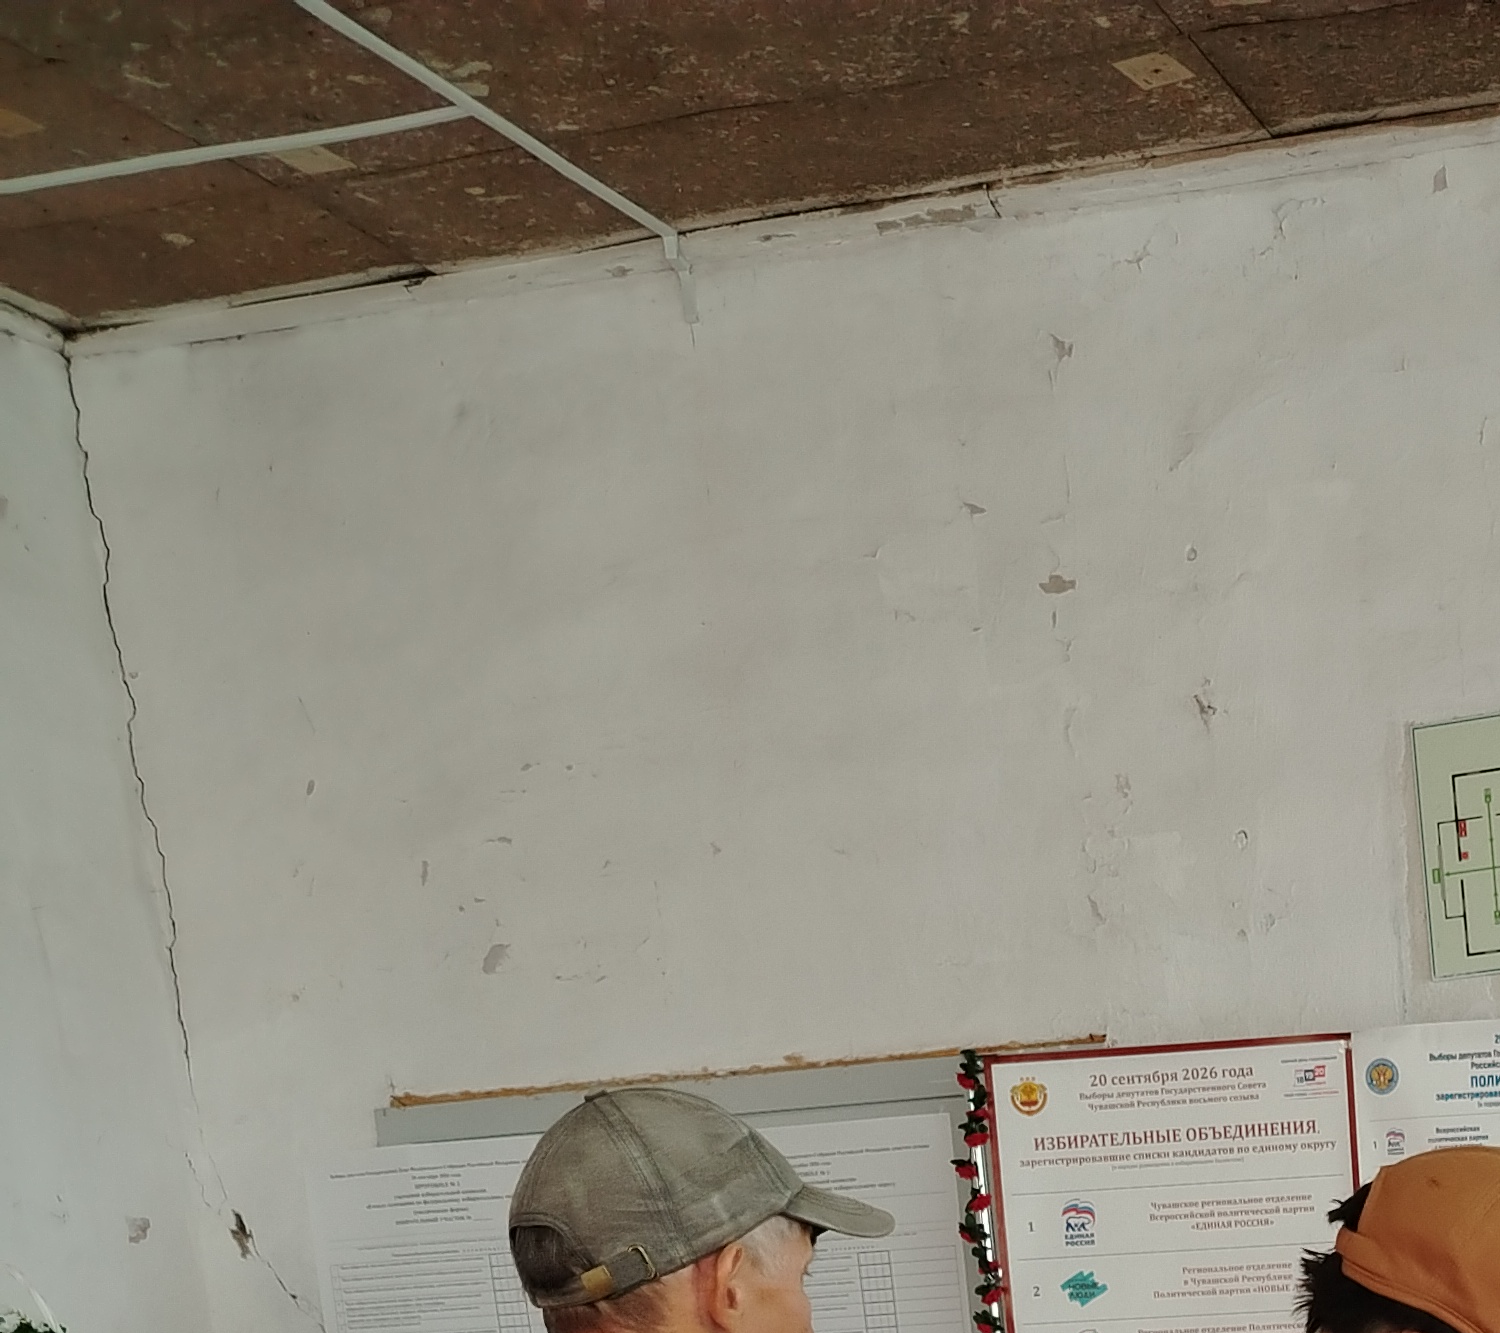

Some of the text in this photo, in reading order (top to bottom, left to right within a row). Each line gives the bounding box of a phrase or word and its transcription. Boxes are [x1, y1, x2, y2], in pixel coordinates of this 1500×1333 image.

[1429, 1053, 1457, 1061] Выборы
[1089, 1066, 1253, 1087] 20 сентября 2026 года
[1079, 1082, 1266, 1100] Выборы депутатов Государственного Совета
[1088, 1101, 1135, 1111] Чувашской
[1137, 1100, 1187, 1108] Республики
[1229, 1094, 1259, 1102] созыва
[1034, 1120, 1320, 1151] ИЗБИРАТЕЛЬНЫЕ ОБЪЕДИНЕНИЯ,
[1020, 1154, 1131, 1168] зарегистрировавшие
[1133, 1151, 1170, 1162] списки
[1172, 1147, 1235, 1158] кандидатов
[1237, 1146, 1250, 1154] по
[1252, 1142, 1298, 1154] единому
[1301, 1140, 1336, 1151] округу
[1028, 1222, 1034, 1232] 1
[1191, 1218, 1274, 1230] «ЕДИНАЯ РОССИЯ»
[1065, 1239, 1095, 1247] РОССИЯ
[1033, 1286, 1041, 1297] 2
